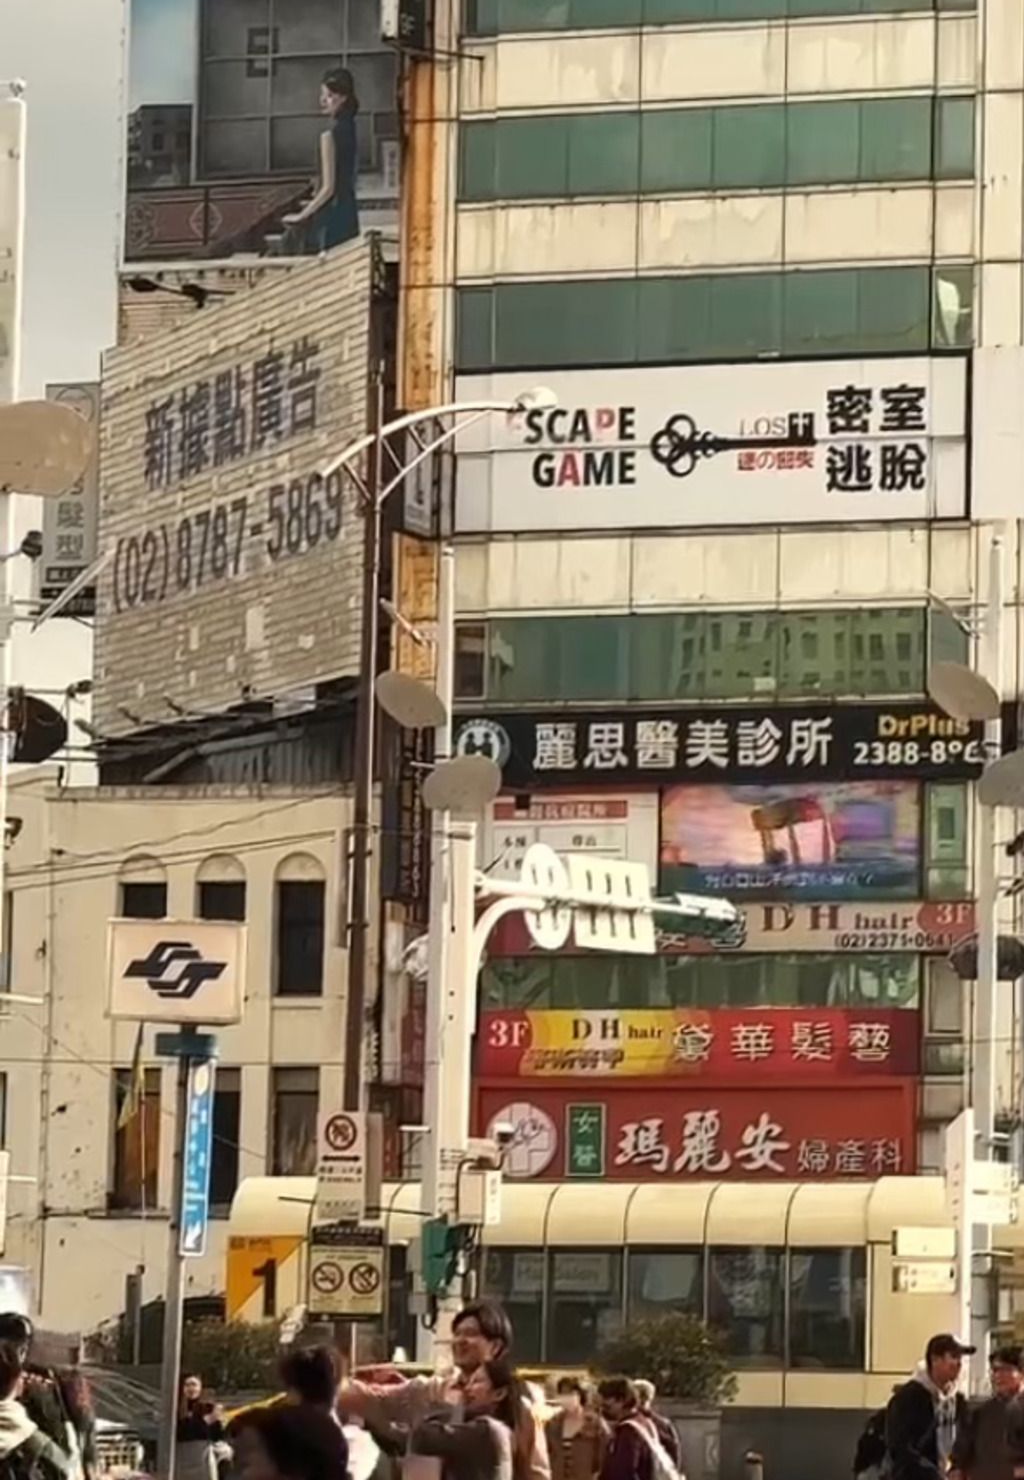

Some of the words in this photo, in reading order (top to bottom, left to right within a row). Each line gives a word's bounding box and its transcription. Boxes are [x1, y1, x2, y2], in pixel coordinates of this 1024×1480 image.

[826, 384, 927, 434] 密室
[532, 450, 637, 488] GAME
[826, 444, 927, 493] 逃脫
[531, 717, 833, 771] 麗思醫美診所
[877, 714, 971, 737] DrPlus
[936, 902, 971, 924] 3F
[488, 1021, 529, 1047] 3F
[627, 1026, 664, 1040] hair
[615, 1108, 792, 1173] 瑪麗安
[797, 1137, 903, 1173] 婦產科
[252, 1258, 277, 1318] 1
